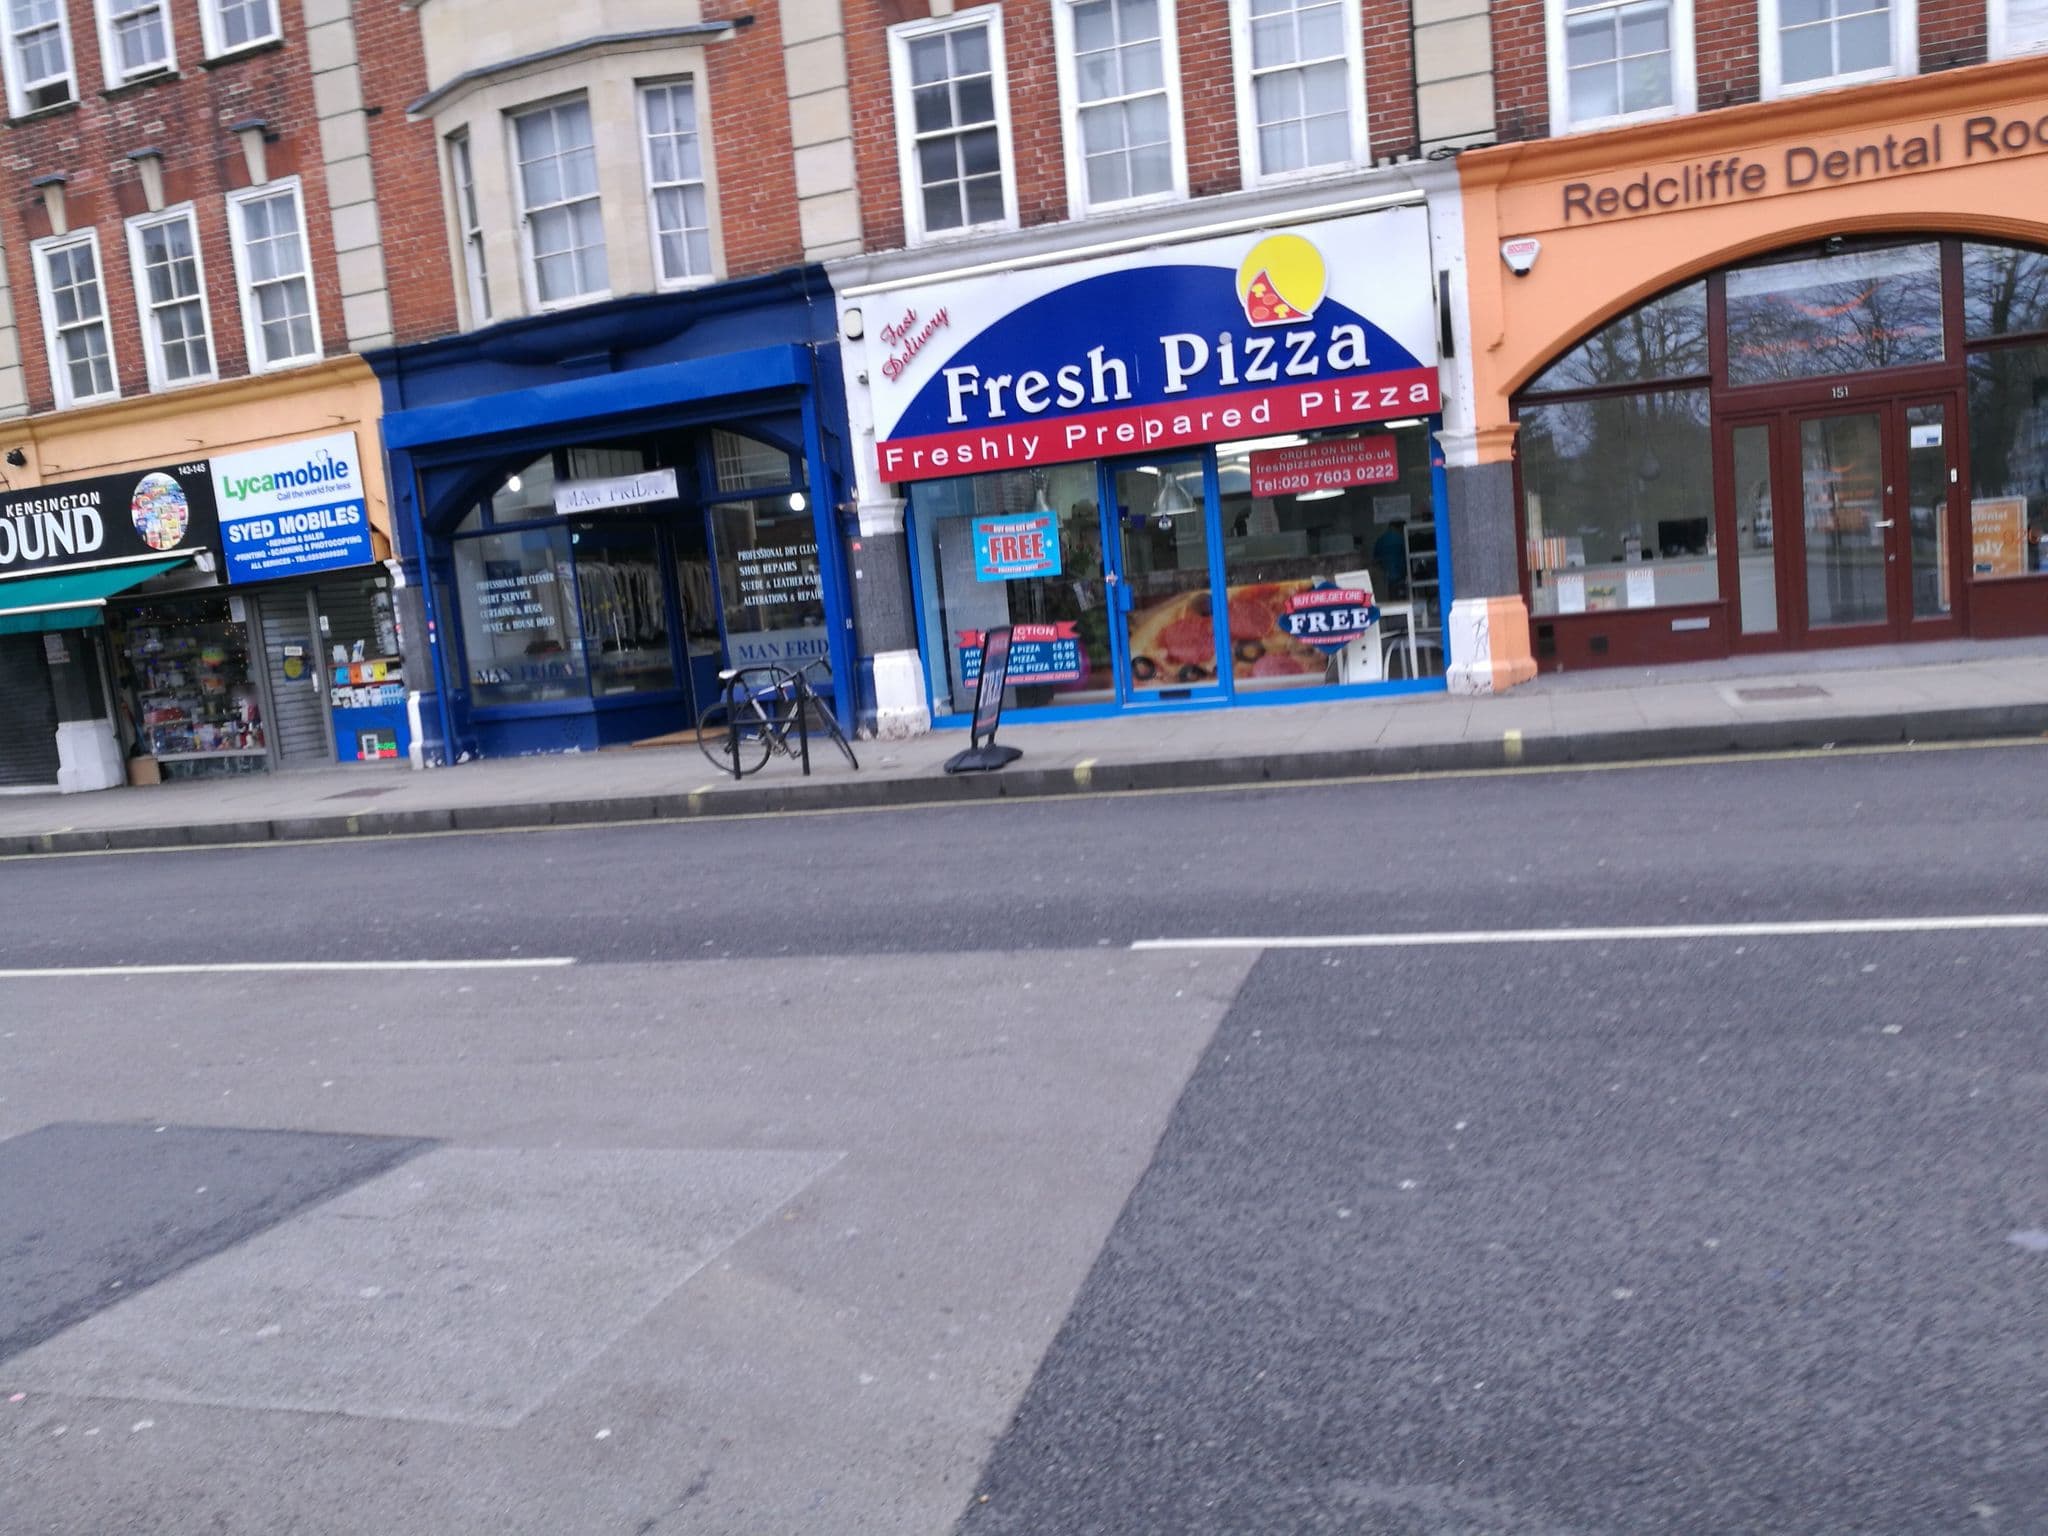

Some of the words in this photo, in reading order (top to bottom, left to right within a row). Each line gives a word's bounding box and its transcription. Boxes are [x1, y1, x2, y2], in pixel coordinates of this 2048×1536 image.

[1563, 156, 1767, 221] Redcliffe
[1785, 123, 1942, 188] Dental
[880, 307, 917, 346] Fast
[882, 306, 951, 382] Delivery
[942, 344, 1133, 424] Fresh
[1159, 323, 1371, 394] Pizza
[1831, 386, 1849, 399] 151
[885, 433, 1040, 472] Freshly
[1065, 398, 1271, 449] Prepared
[1299, 381, 1430, 418] Pizza
[1280, 450, 1318, 461] ORDER
[1321, 447, 1338, 456] ON
[1341, 442, 1366, 453] LINE
[222, 457, 350, 501] Lycamobile
[1256, 474, 1310, 492] Tel:020
[1314, 469, 1352, 484] 7603
[1356, 464, 1394, 480] 0222
[276, 493, 291, 501] Call
[292, 489, 306, 498] the
[306, 486, 325, 497] world
[325, 484, 336, 493] for
[336, 482, 352, 492] less
[5, 491, 101, 519] KENSINGTON
[228, 519, 275, 544] SYED
[278, 505, 361, 535] MOBILES
[737, 547, 783, 561] PROFESSIONAL
[785, 545, 798, 556] DRY
[989, 531, 1046, 564] FREE
[740, 565, 760, 576] SHOE
[763, 561, 798, 574] REPAIRS
[773, 577, 805, 588] LEATHER
[502, 590, 532, 602] SERVICE
[744, 592, 788, 606] ALTERATIONS
[1288, 608, 1371, 635] FREE
[740, 641, 781, 660] MAN
[1017, 644, 1041, 654] PIZZA
[1013, 654, 1036, 664] PIZZA
[1026, 663, 1050, 673] PIZZA
